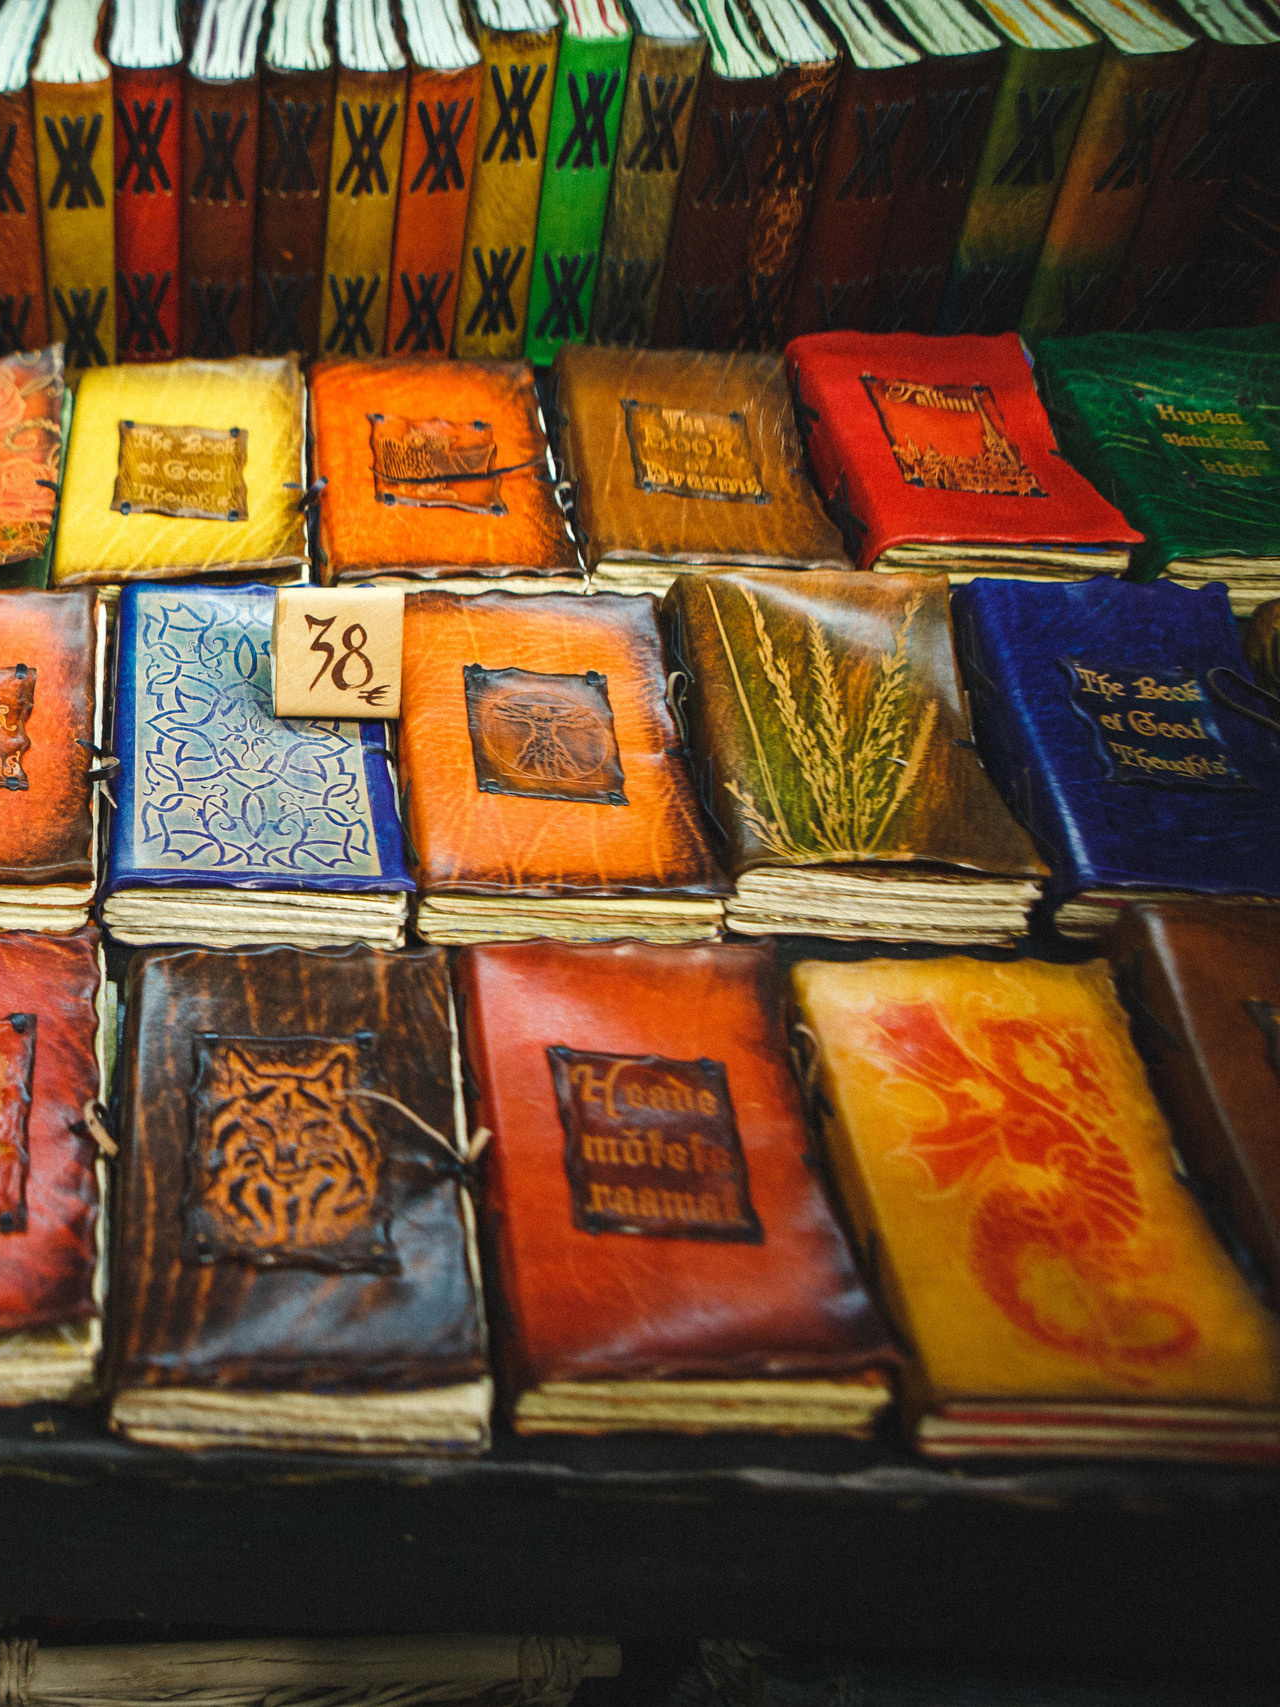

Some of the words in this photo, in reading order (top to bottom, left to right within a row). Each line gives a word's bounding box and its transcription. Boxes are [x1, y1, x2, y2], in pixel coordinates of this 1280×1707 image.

[662, 408, 706, 435] The
[131, 429, 173, 453] The
[181, 433, 236, 454] Book
[642, 426, 745, 464] Book
[138, 462, 159, 476] of
[164, 460, 225, 481] Good
[641, 461, 762, 495] Dreams
[685, 459, 709, 475] of
[1074, 666, 1127, 702] The
[1131, 676, 1203, 702] Book
[1099, 712, 1125, 732] of
[1127, 710, 1208, 739] Good
[1108, 741, 1228, 780] Thoughts
